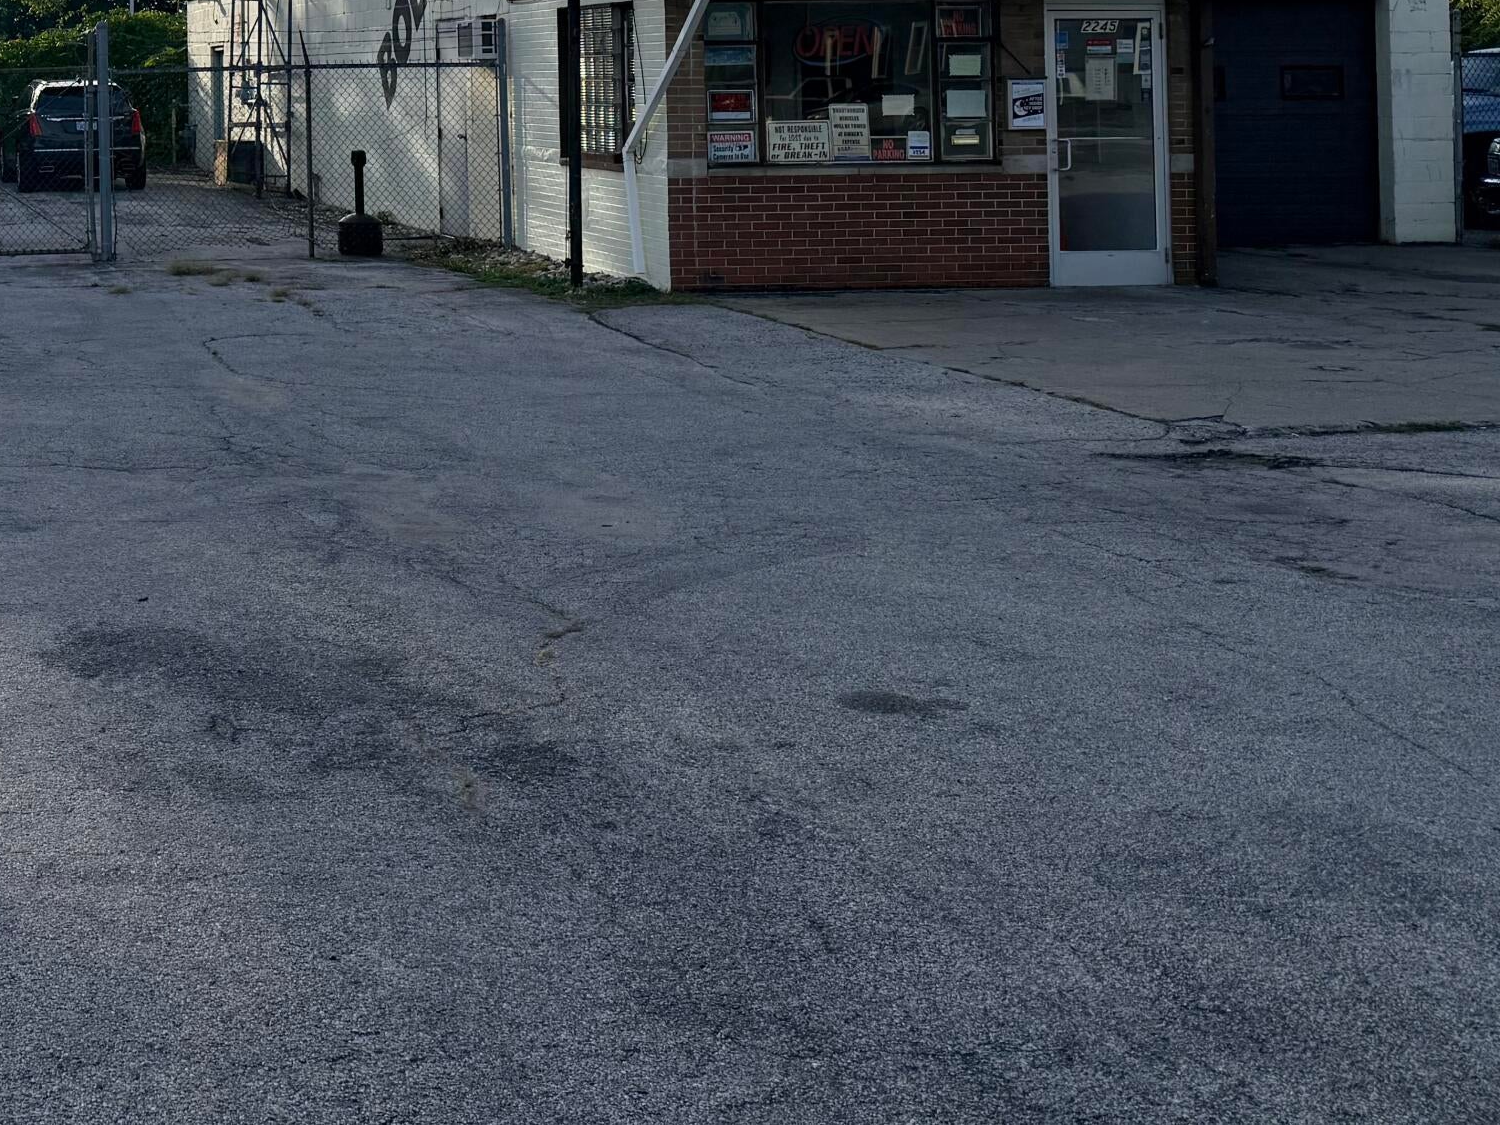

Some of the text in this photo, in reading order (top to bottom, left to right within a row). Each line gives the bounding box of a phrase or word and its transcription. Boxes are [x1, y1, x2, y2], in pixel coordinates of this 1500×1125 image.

[1082, 20, 1118, 32] 2245
[795, 25, 880, 58] OPEN
[774, 125, 822, 134] NOT RESPONSIBLE
[711, 133, 750, 142] WARNING
[800, 142, 825, 150] THEFT
[883, 138, 894, 150] NO
[784, 151, 828, 160] BREAK-IN
[872, 149, 905, 160] PARKING
